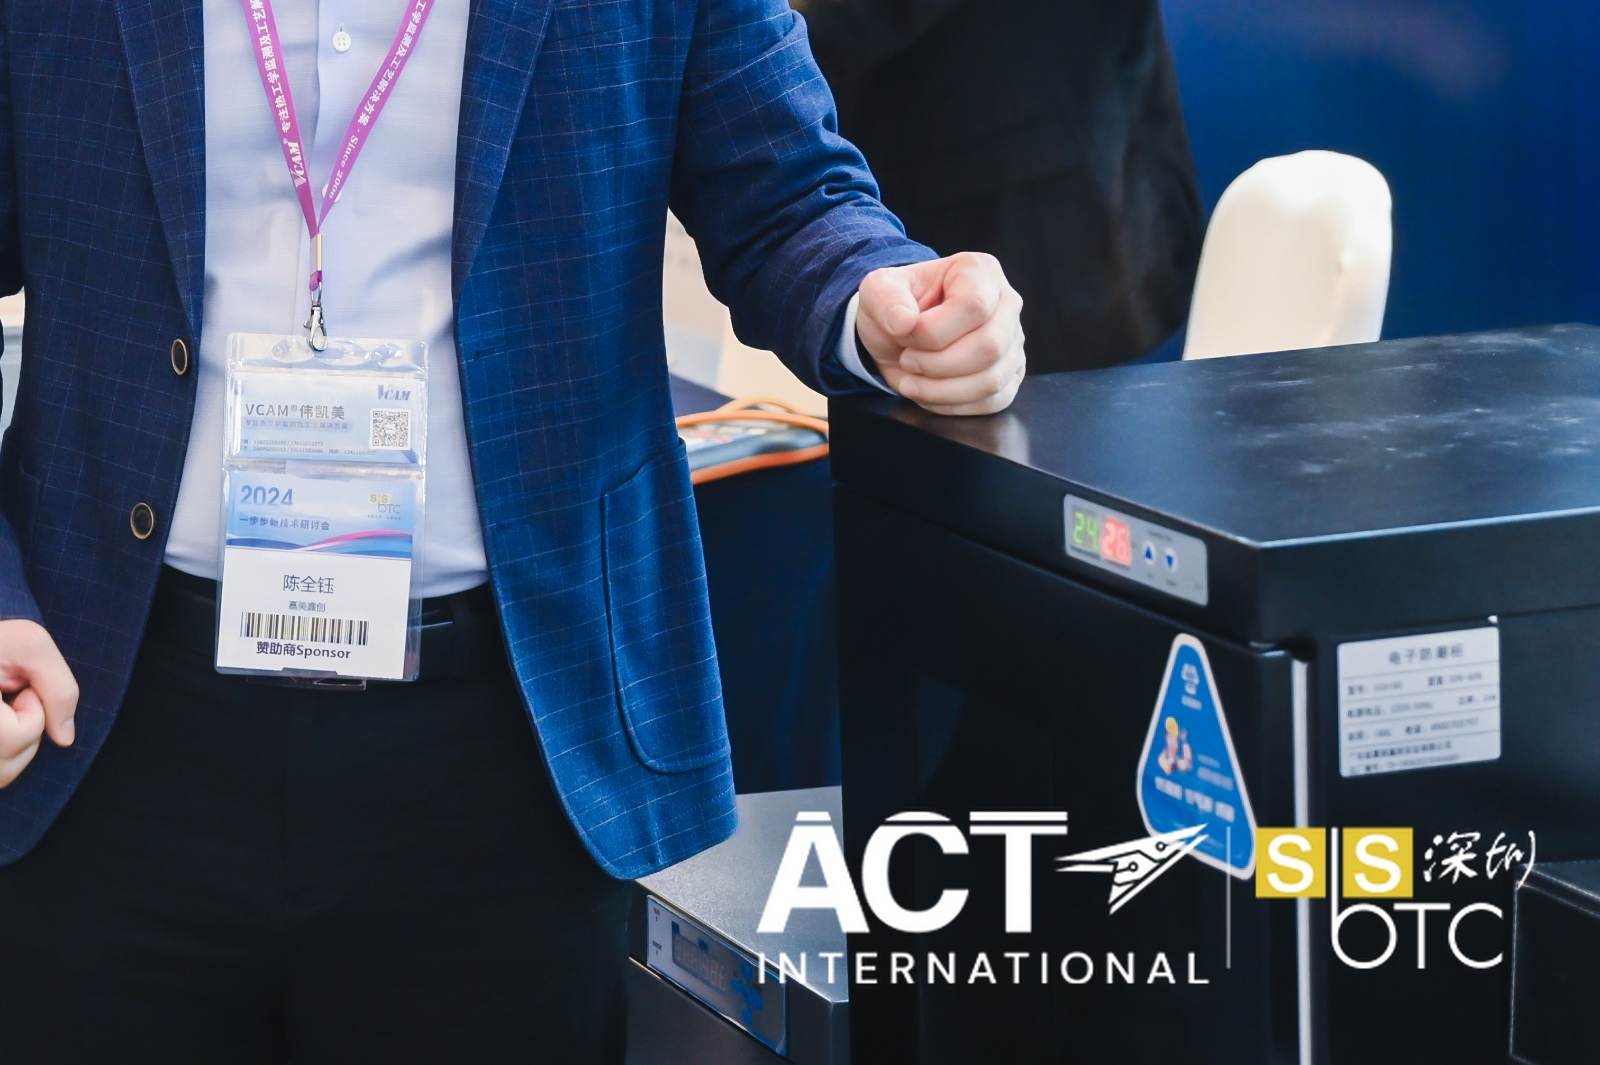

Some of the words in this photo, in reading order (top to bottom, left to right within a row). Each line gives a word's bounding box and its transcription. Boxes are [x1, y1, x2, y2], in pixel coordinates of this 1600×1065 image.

[240, 485, 293, 507] 2024
[240, 516, 330, 530] 一步步新技术研讨会
[1073, 512, 1098, 550] 24
[1101, 518, 1131, 565] 26
[283, 575, 334, 594] 陈全钰
